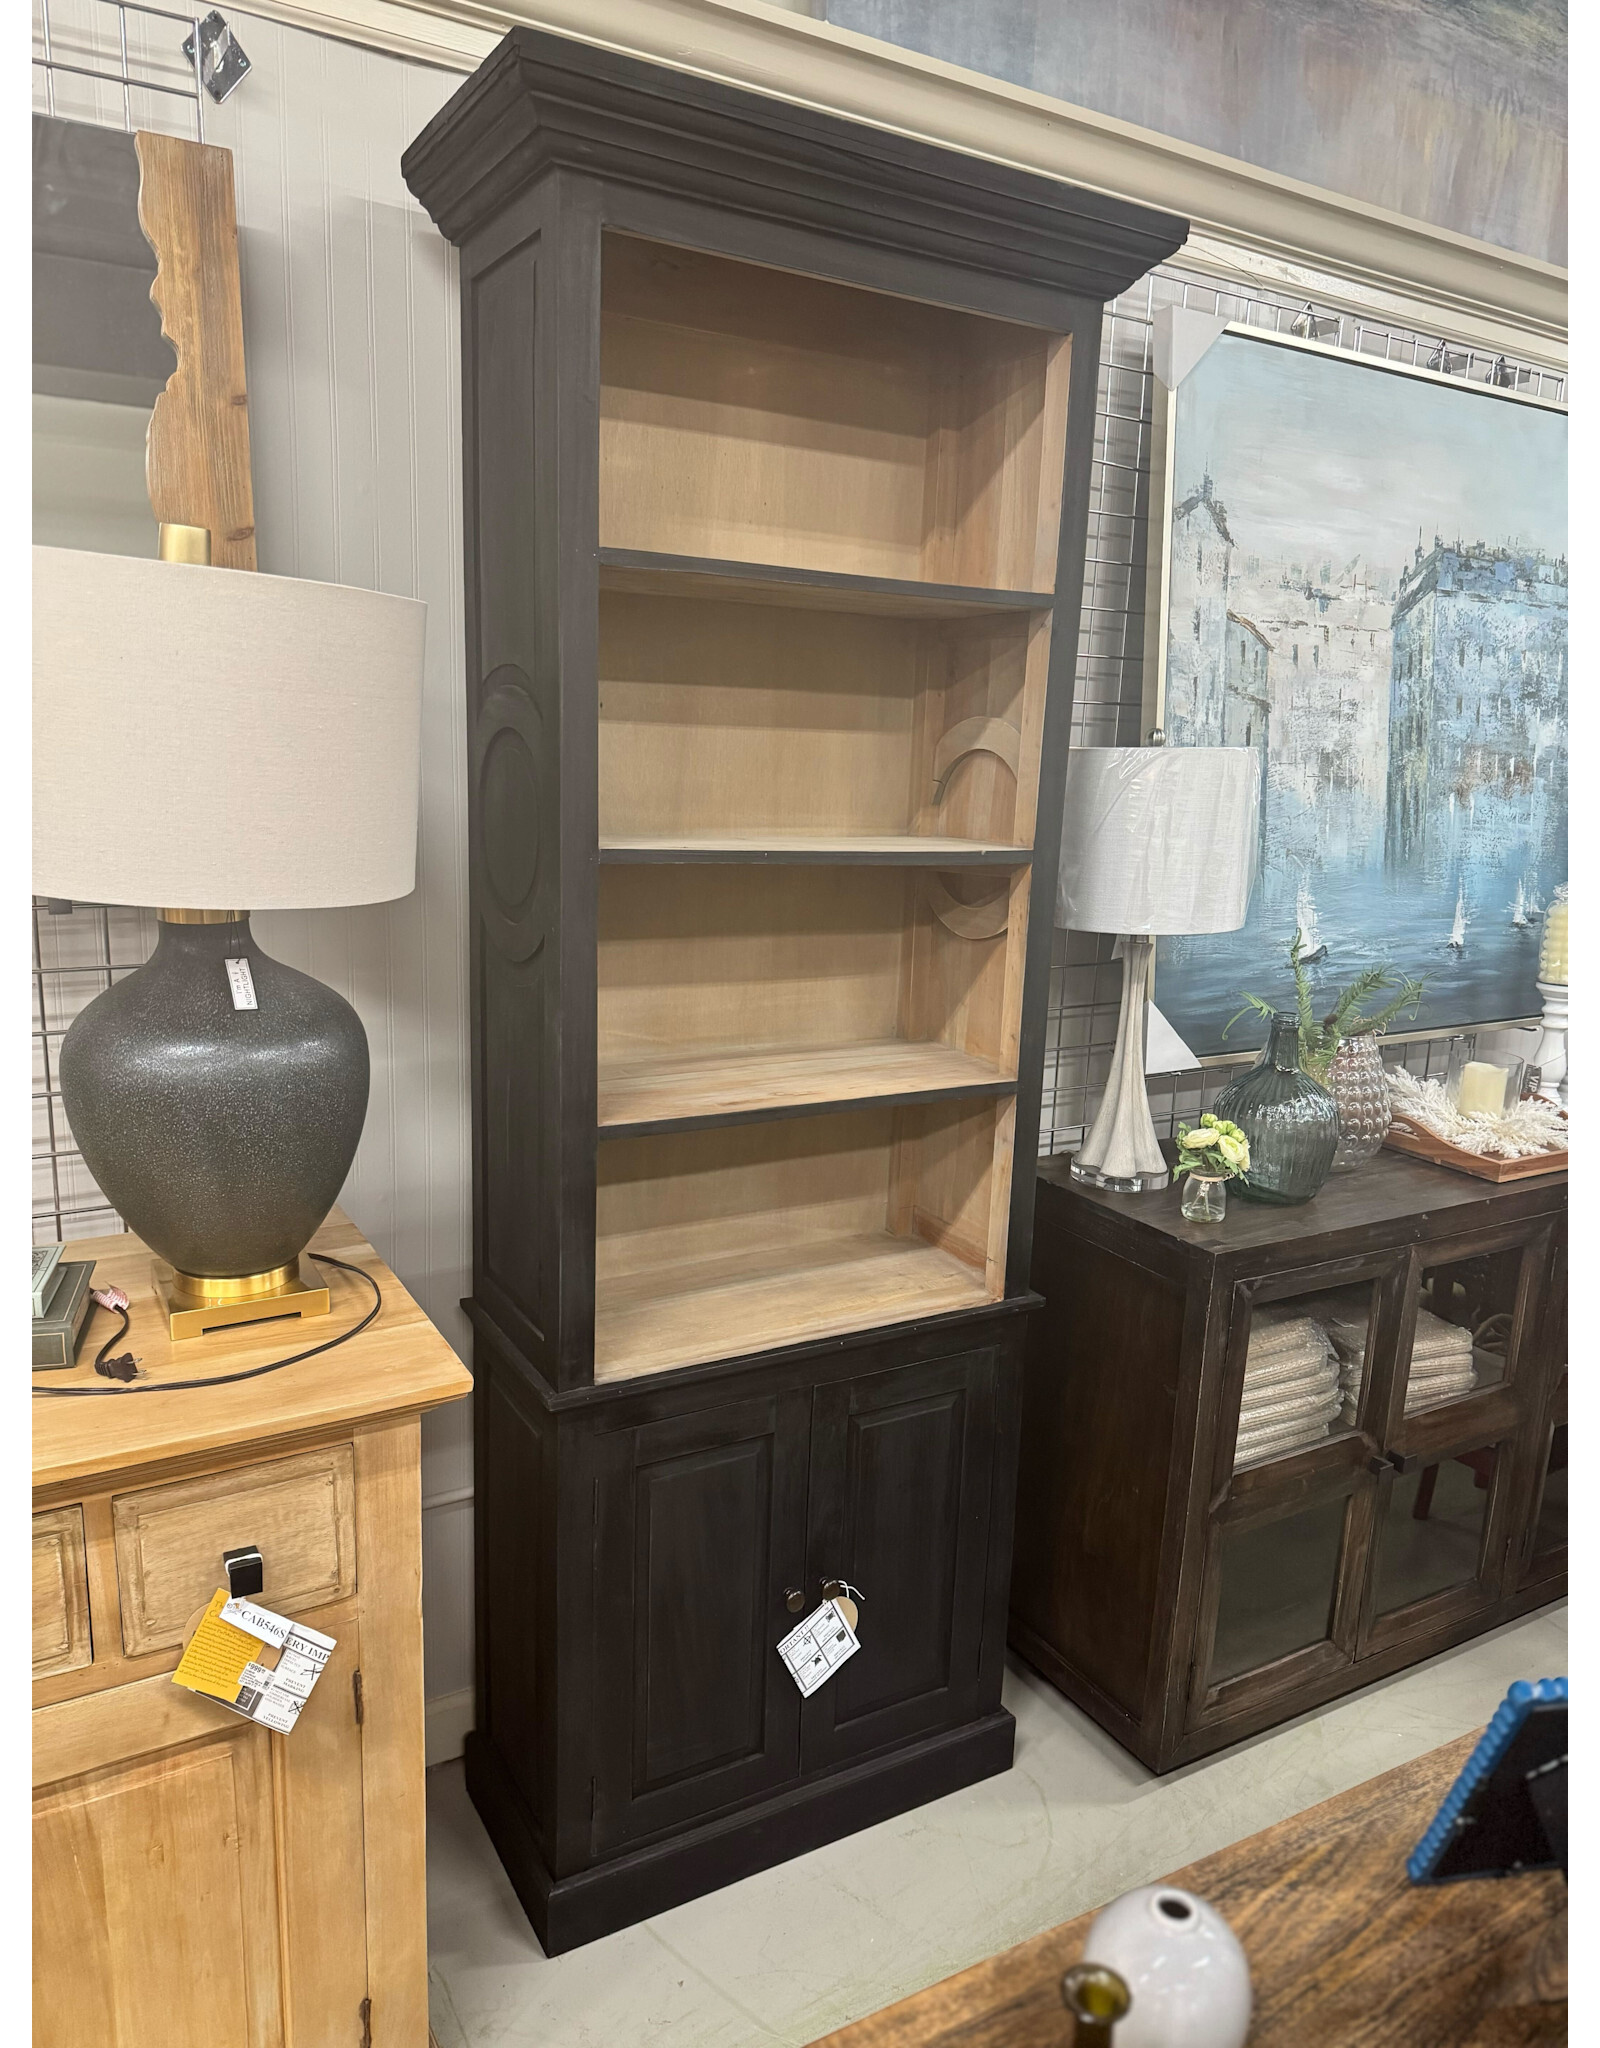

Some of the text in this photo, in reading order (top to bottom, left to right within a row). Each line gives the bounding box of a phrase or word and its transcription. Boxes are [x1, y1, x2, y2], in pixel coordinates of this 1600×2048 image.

[240, 968, 253, 1005] NIGHTLIGHT
[1528, 1075, 1540, 1093] VIP
[241, 1611, 286, 1638] CAB546S
[285, 1636, 307, 1651] ERY
